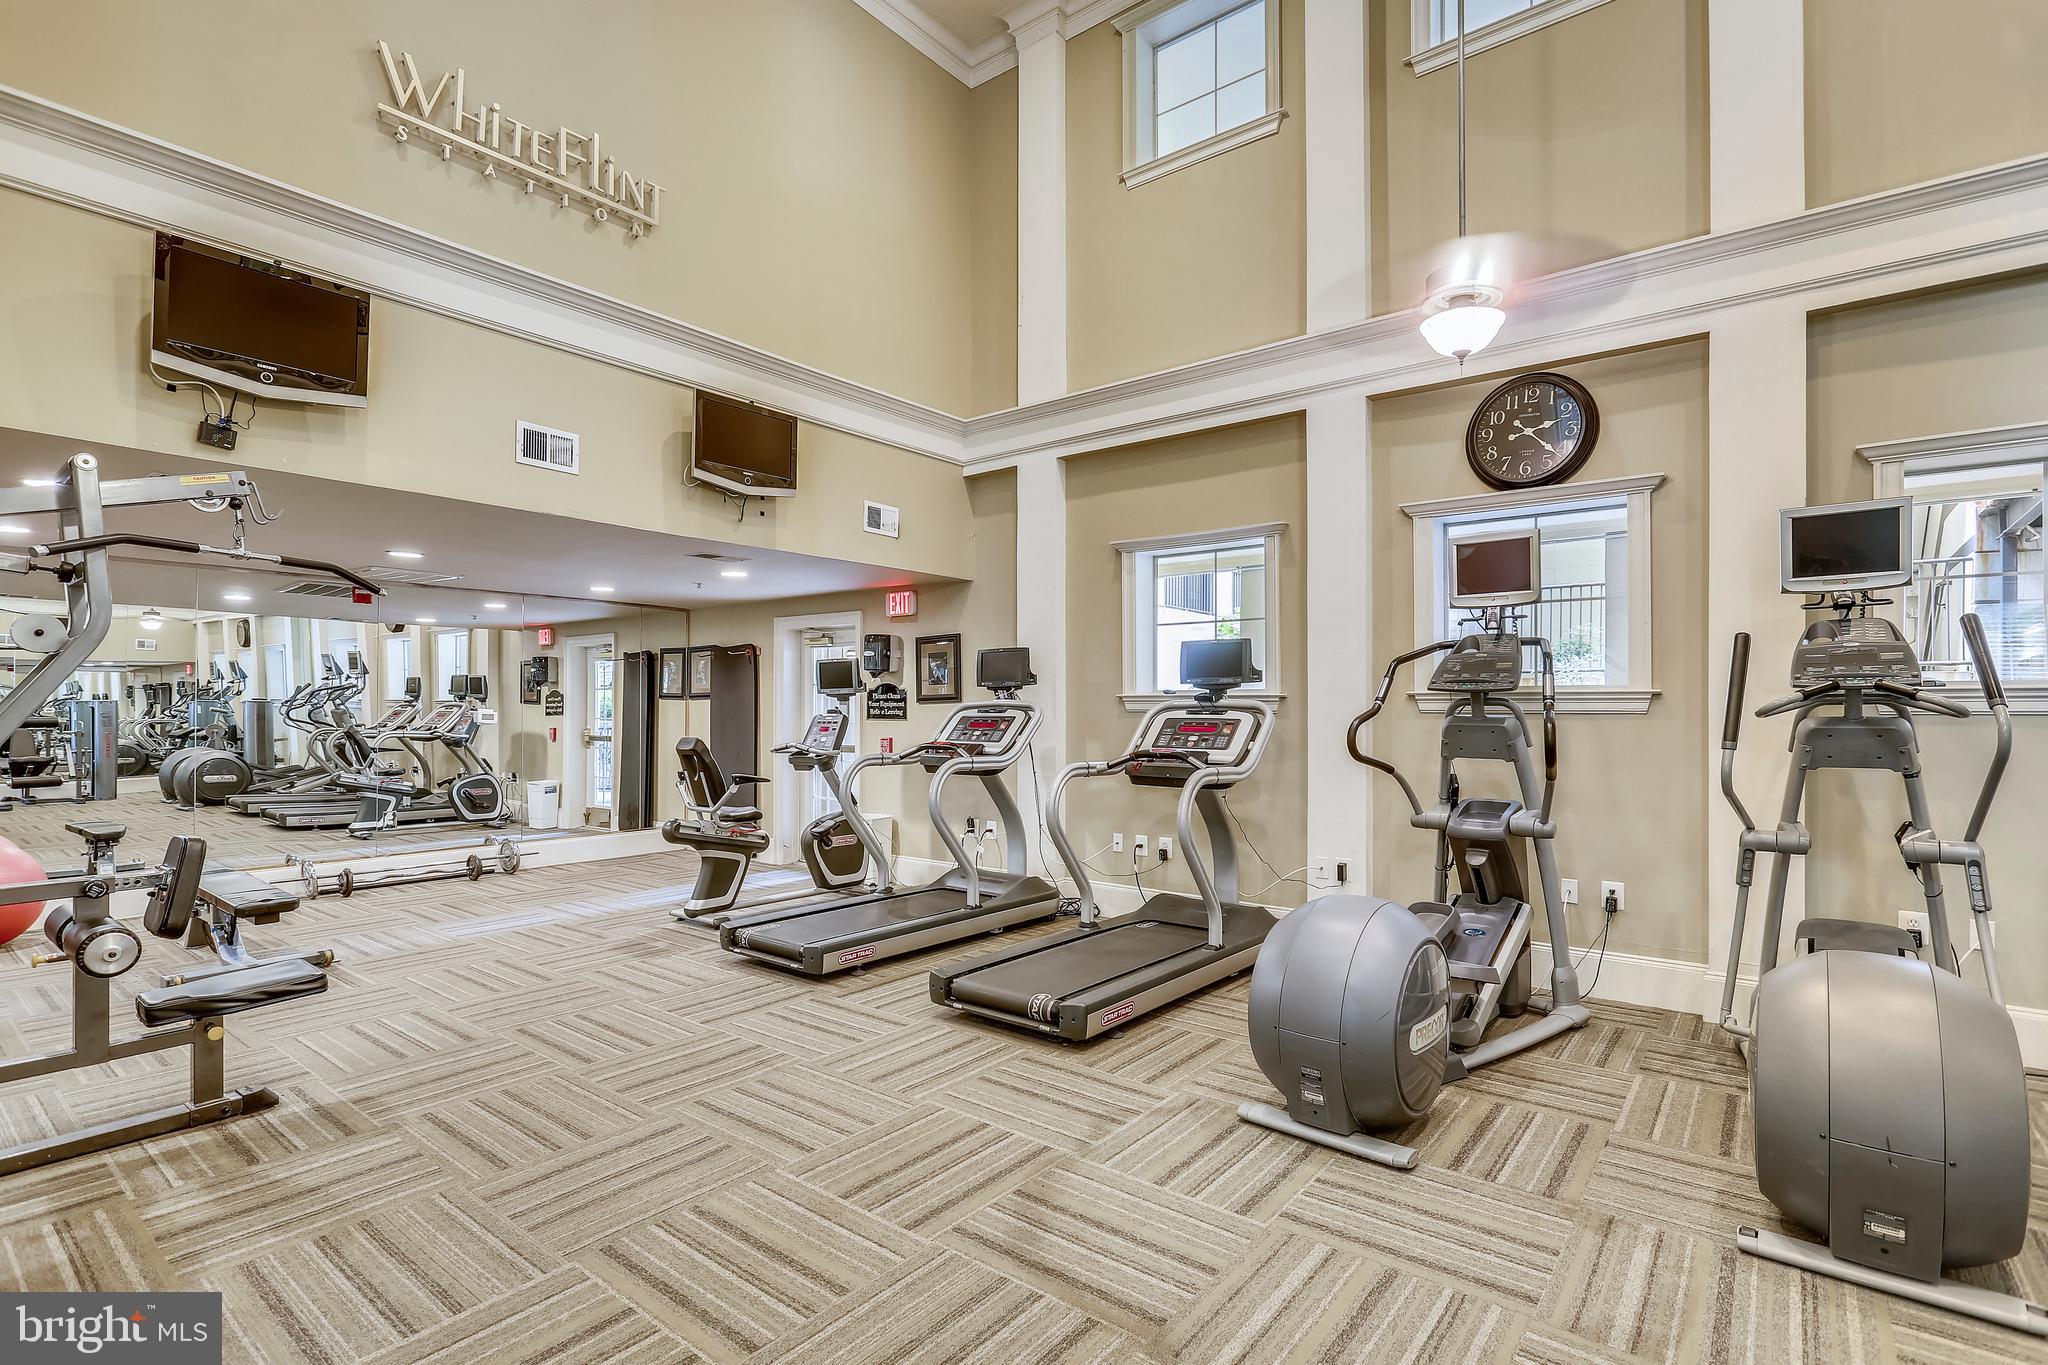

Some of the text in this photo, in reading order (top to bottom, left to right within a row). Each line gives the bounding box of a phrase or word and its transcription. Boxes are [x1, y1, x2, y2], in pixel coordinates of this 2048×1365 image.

[394, 125, 644, 237] STATION
[1505, 395, 1519, 410] 11
[1523, 387, 1541, 403] 12
[1549, 390, 1554, 405] 1
[1561, 402, 1573, 418] 2
[1489, 410, 1506, 426] 10
[1481, 428, 1494, 443] 9
[1565, 421, 1578, 436] 3
[1486, 446, 1498, 460] 8
[1556, 440, 1568, 454] 4
[1501, 456, 1512, 471] 7
[1519, 461, 1531, 475] 6
[1541, 454, 1553, 469] 5
[889, 592, 910, 615] EXIT
[872, 692, 887, 700] Please
[880, 700, 905, 709] Equipment
[885, 708, 904, 717] Leaving
[841, 949, 873, 961] STAR TRAC
[1103, 1005, 1133, 1021] STAR TRAC
